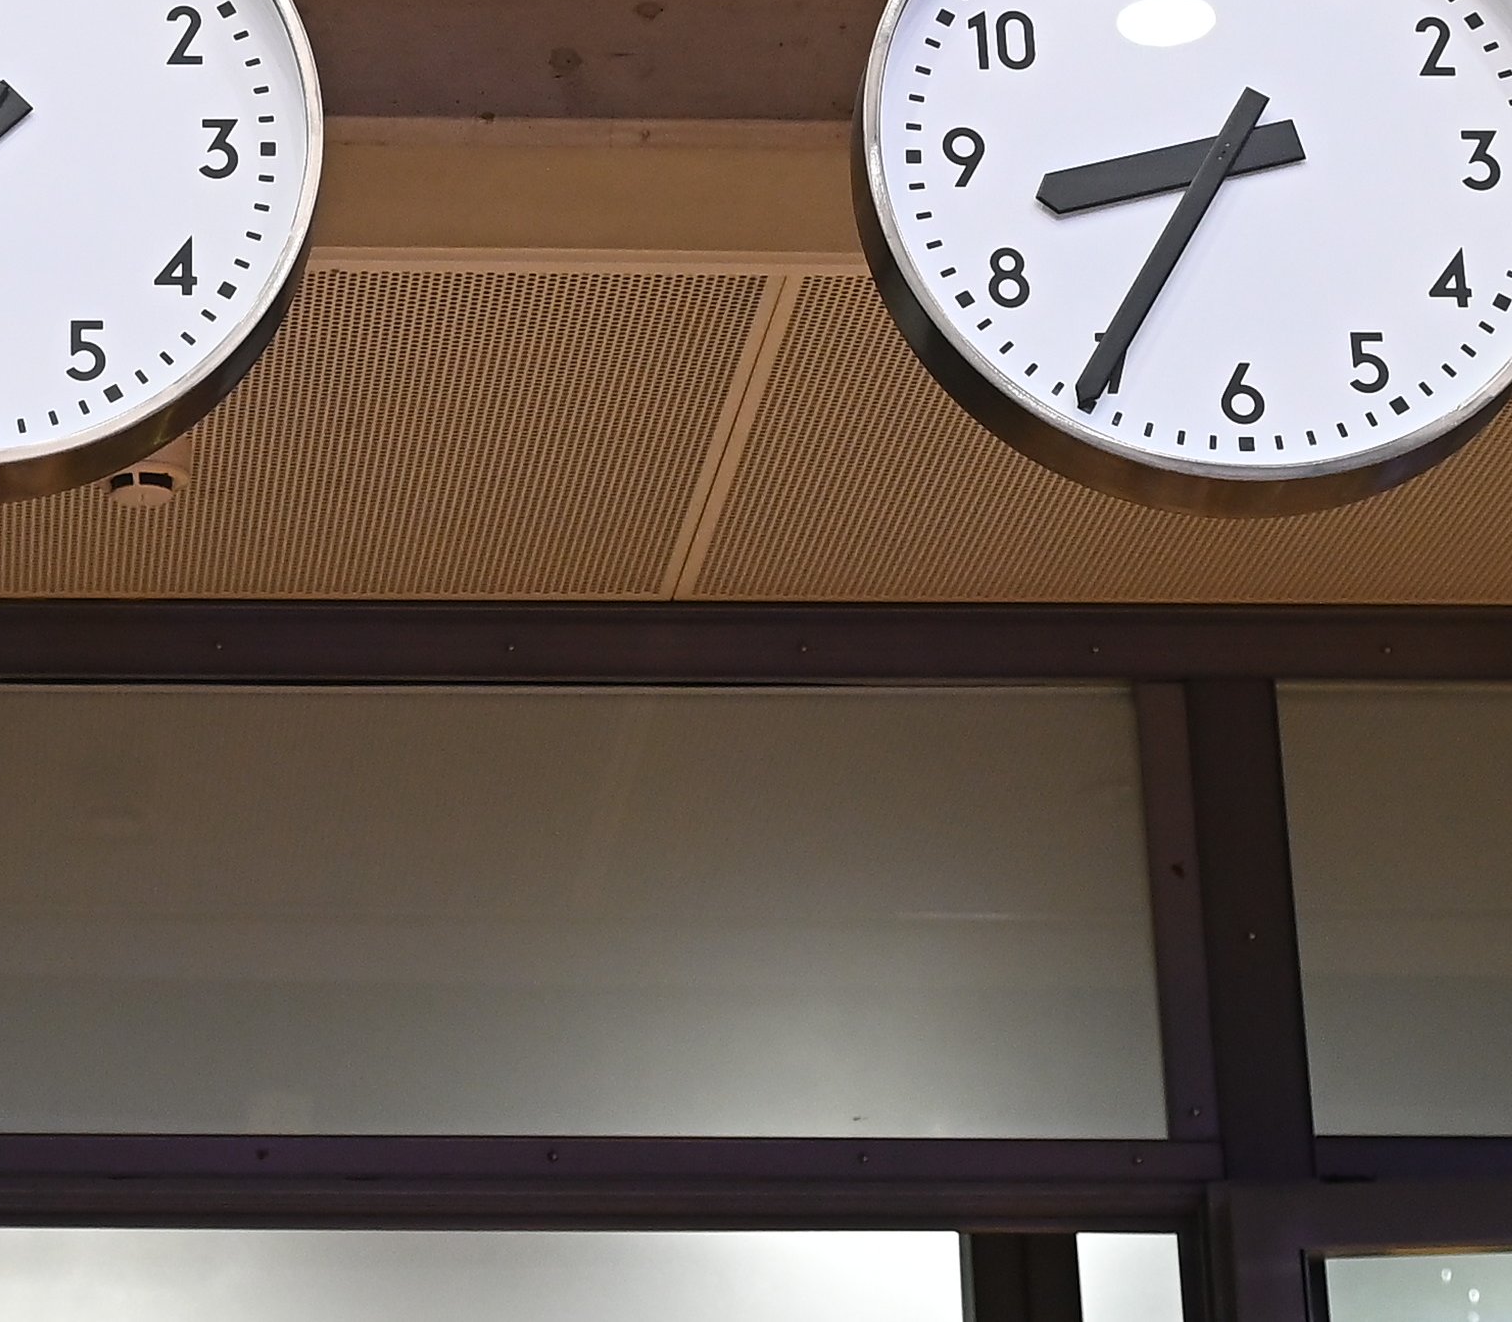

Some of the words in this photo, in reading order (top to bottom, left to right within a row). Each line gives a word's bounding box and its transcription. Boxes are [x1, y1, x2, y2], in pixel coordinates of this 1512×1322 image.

[166, 5, 203, 65] 2
[967, 10, 1036, 70] 10
[1415, 16, 1456, 77] 2
[198, 118, 239, 180] 3
[942, 127, 986, 188] 9
[1460, 130, 1501, 191] 3
[153, 235, 198, 296] 4
[988, 247, 1030, 309] 8
[1428, 247, 1473, 308] 4
[66, 320, 106, 382] 5
[1349, 331, 1390, 394] 5
[1220, 362, 1265, 425] 6
